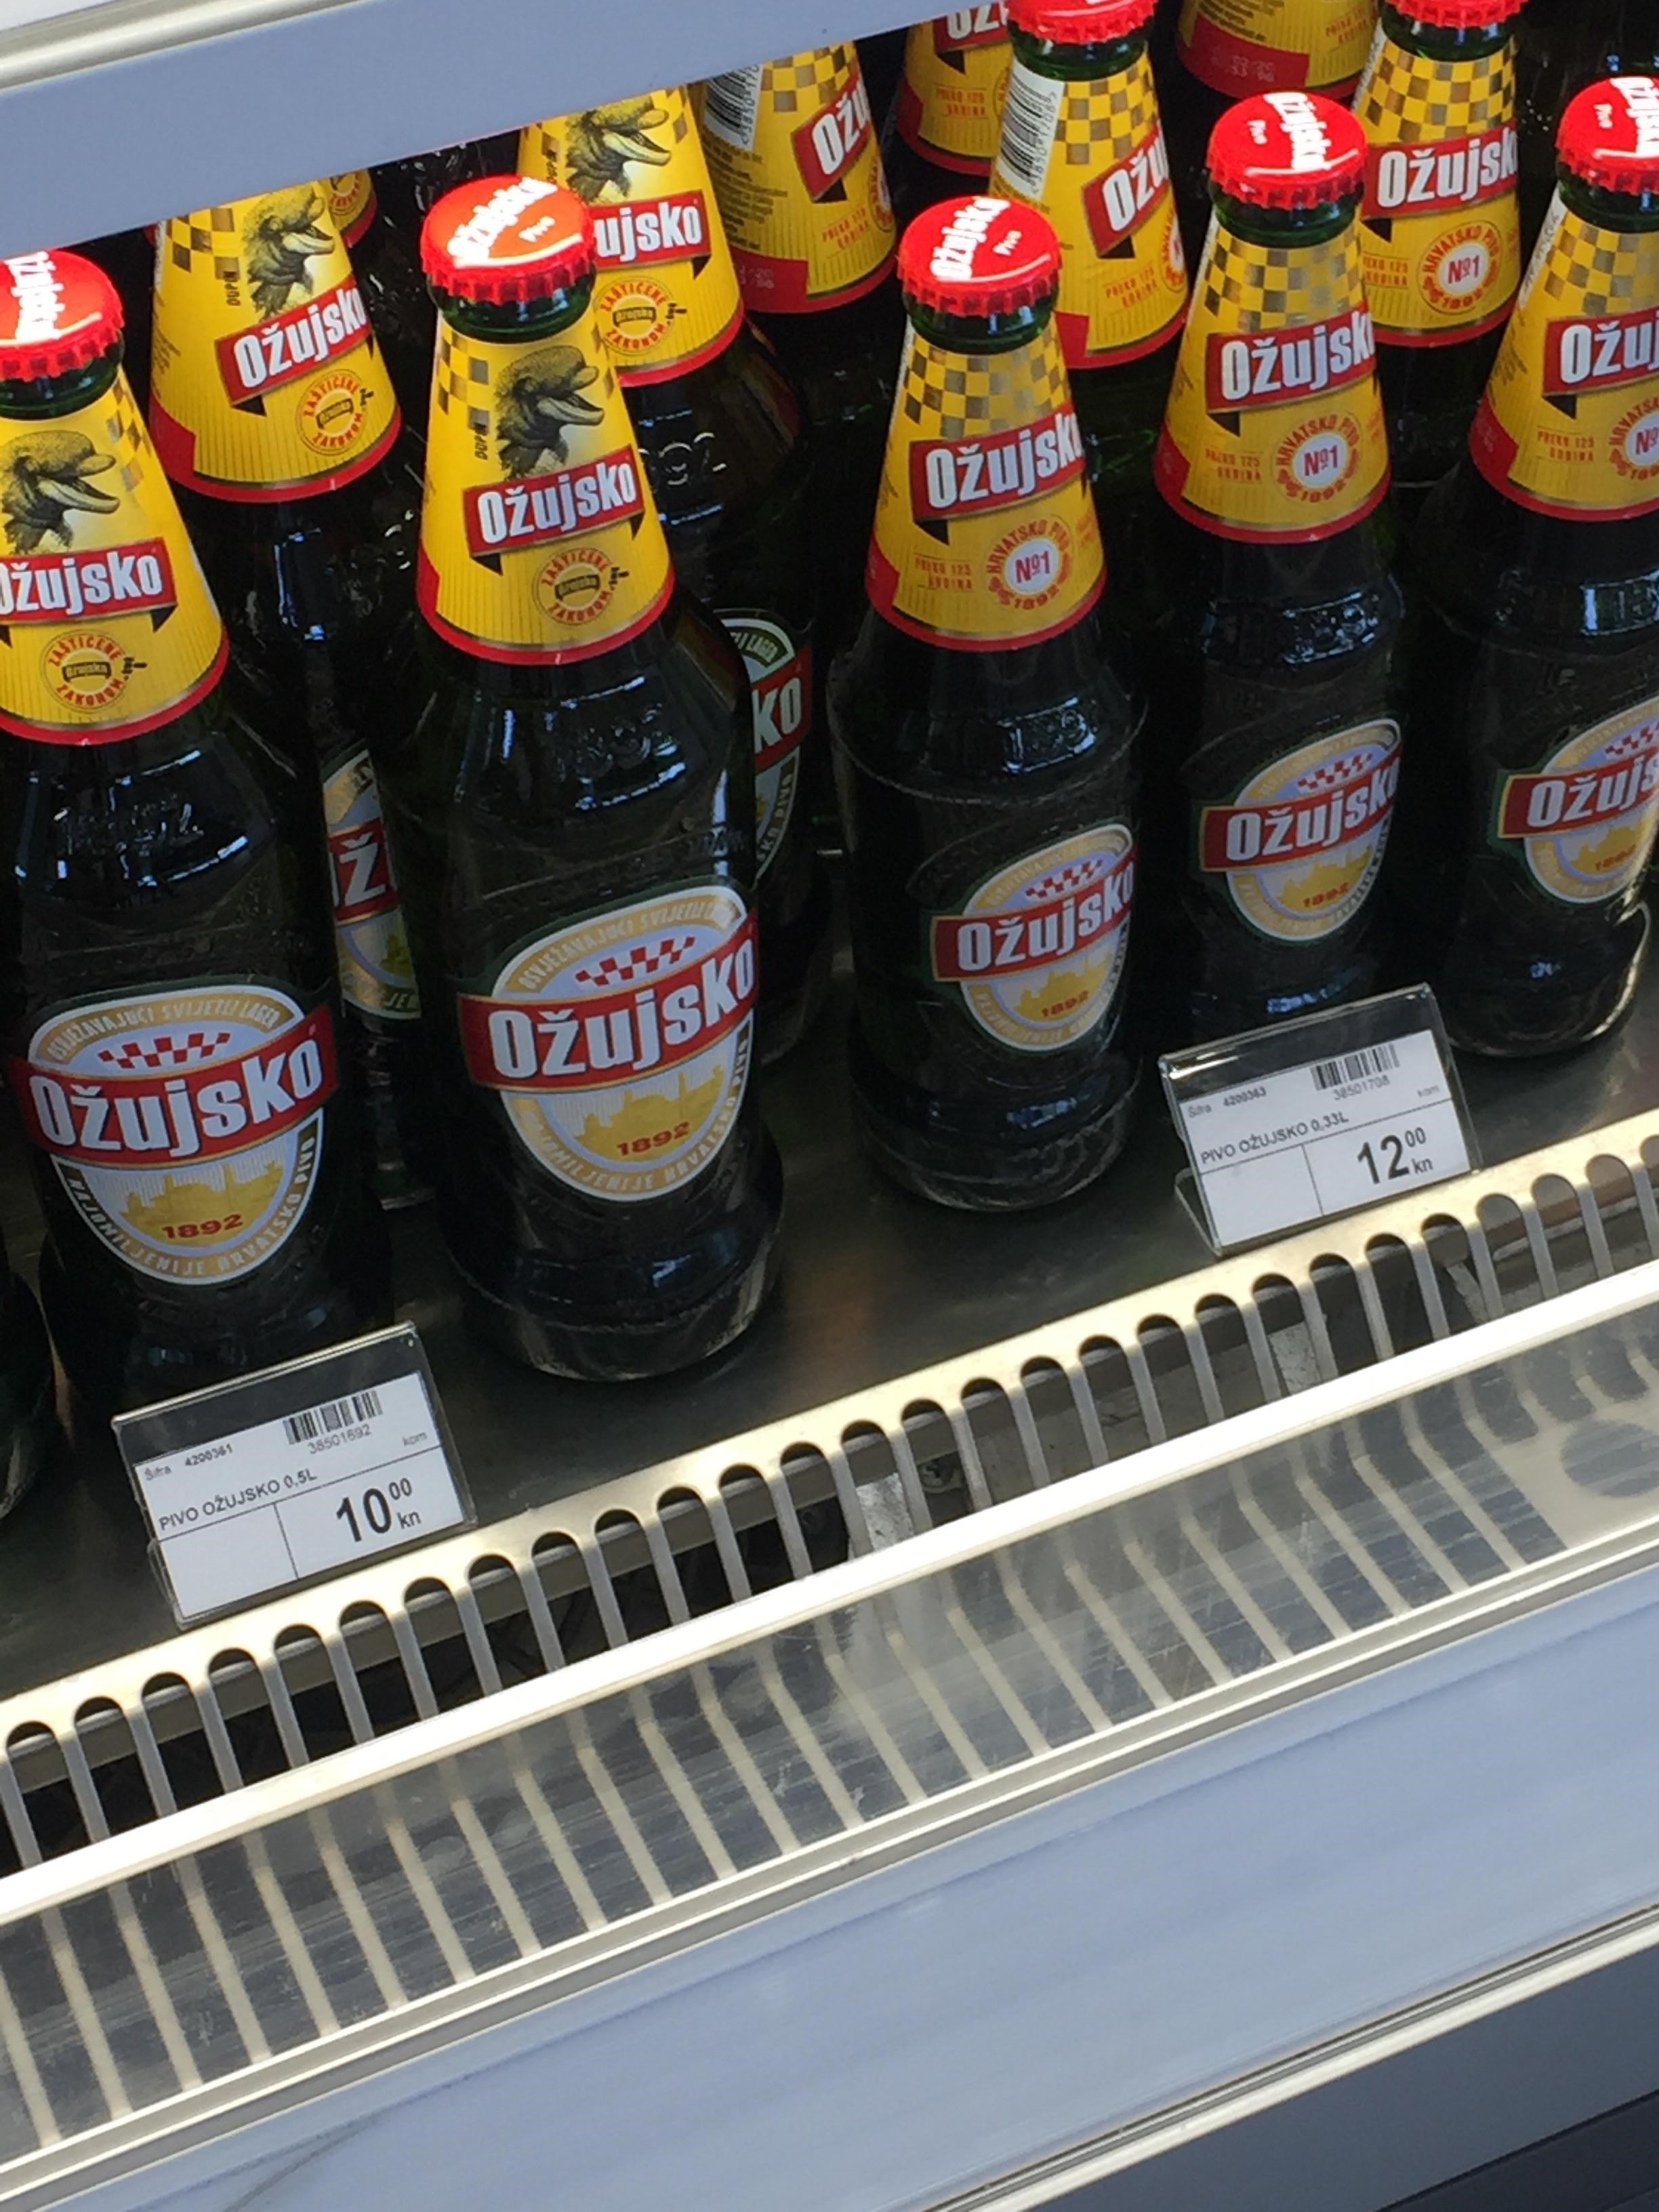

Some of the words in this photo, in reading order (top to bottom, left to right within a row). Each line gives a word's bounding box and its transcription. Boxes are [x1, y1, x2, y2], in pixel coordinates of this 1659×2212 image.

[233, 287, 367, 388] Ožujsko
[477, 462, 638, 544] Ožujsko
[958, 861, 1134, 971] Ožujsko
[489, 939, 754, 1079] Ožujsko
[29, 1039, 323, 1158] Ožujsko
[616, 1121, 690, 1156] 1892
[1201, 1144, 1235, 1164] PIVO
[1239, 1122, 1308, 1153] OŽUJSKO
[1357, 1134, 1410, 1185] 12
[1404, 1127, 1427, 1147] 00
[1412, 1158, 1434, 1174] kn
[162, 1214, 244, 1239] 1892
[158, 1507, 199, 1531] PIVO
[202, 1479, 281, 1516] OŽUJSKO
[283, 1468, 318, 1489] 0,5L
[388, 1477, 413, 1501] 00
[336, 1488, 392, 1542] 10
[396, 1511, 422, 1530] kn
